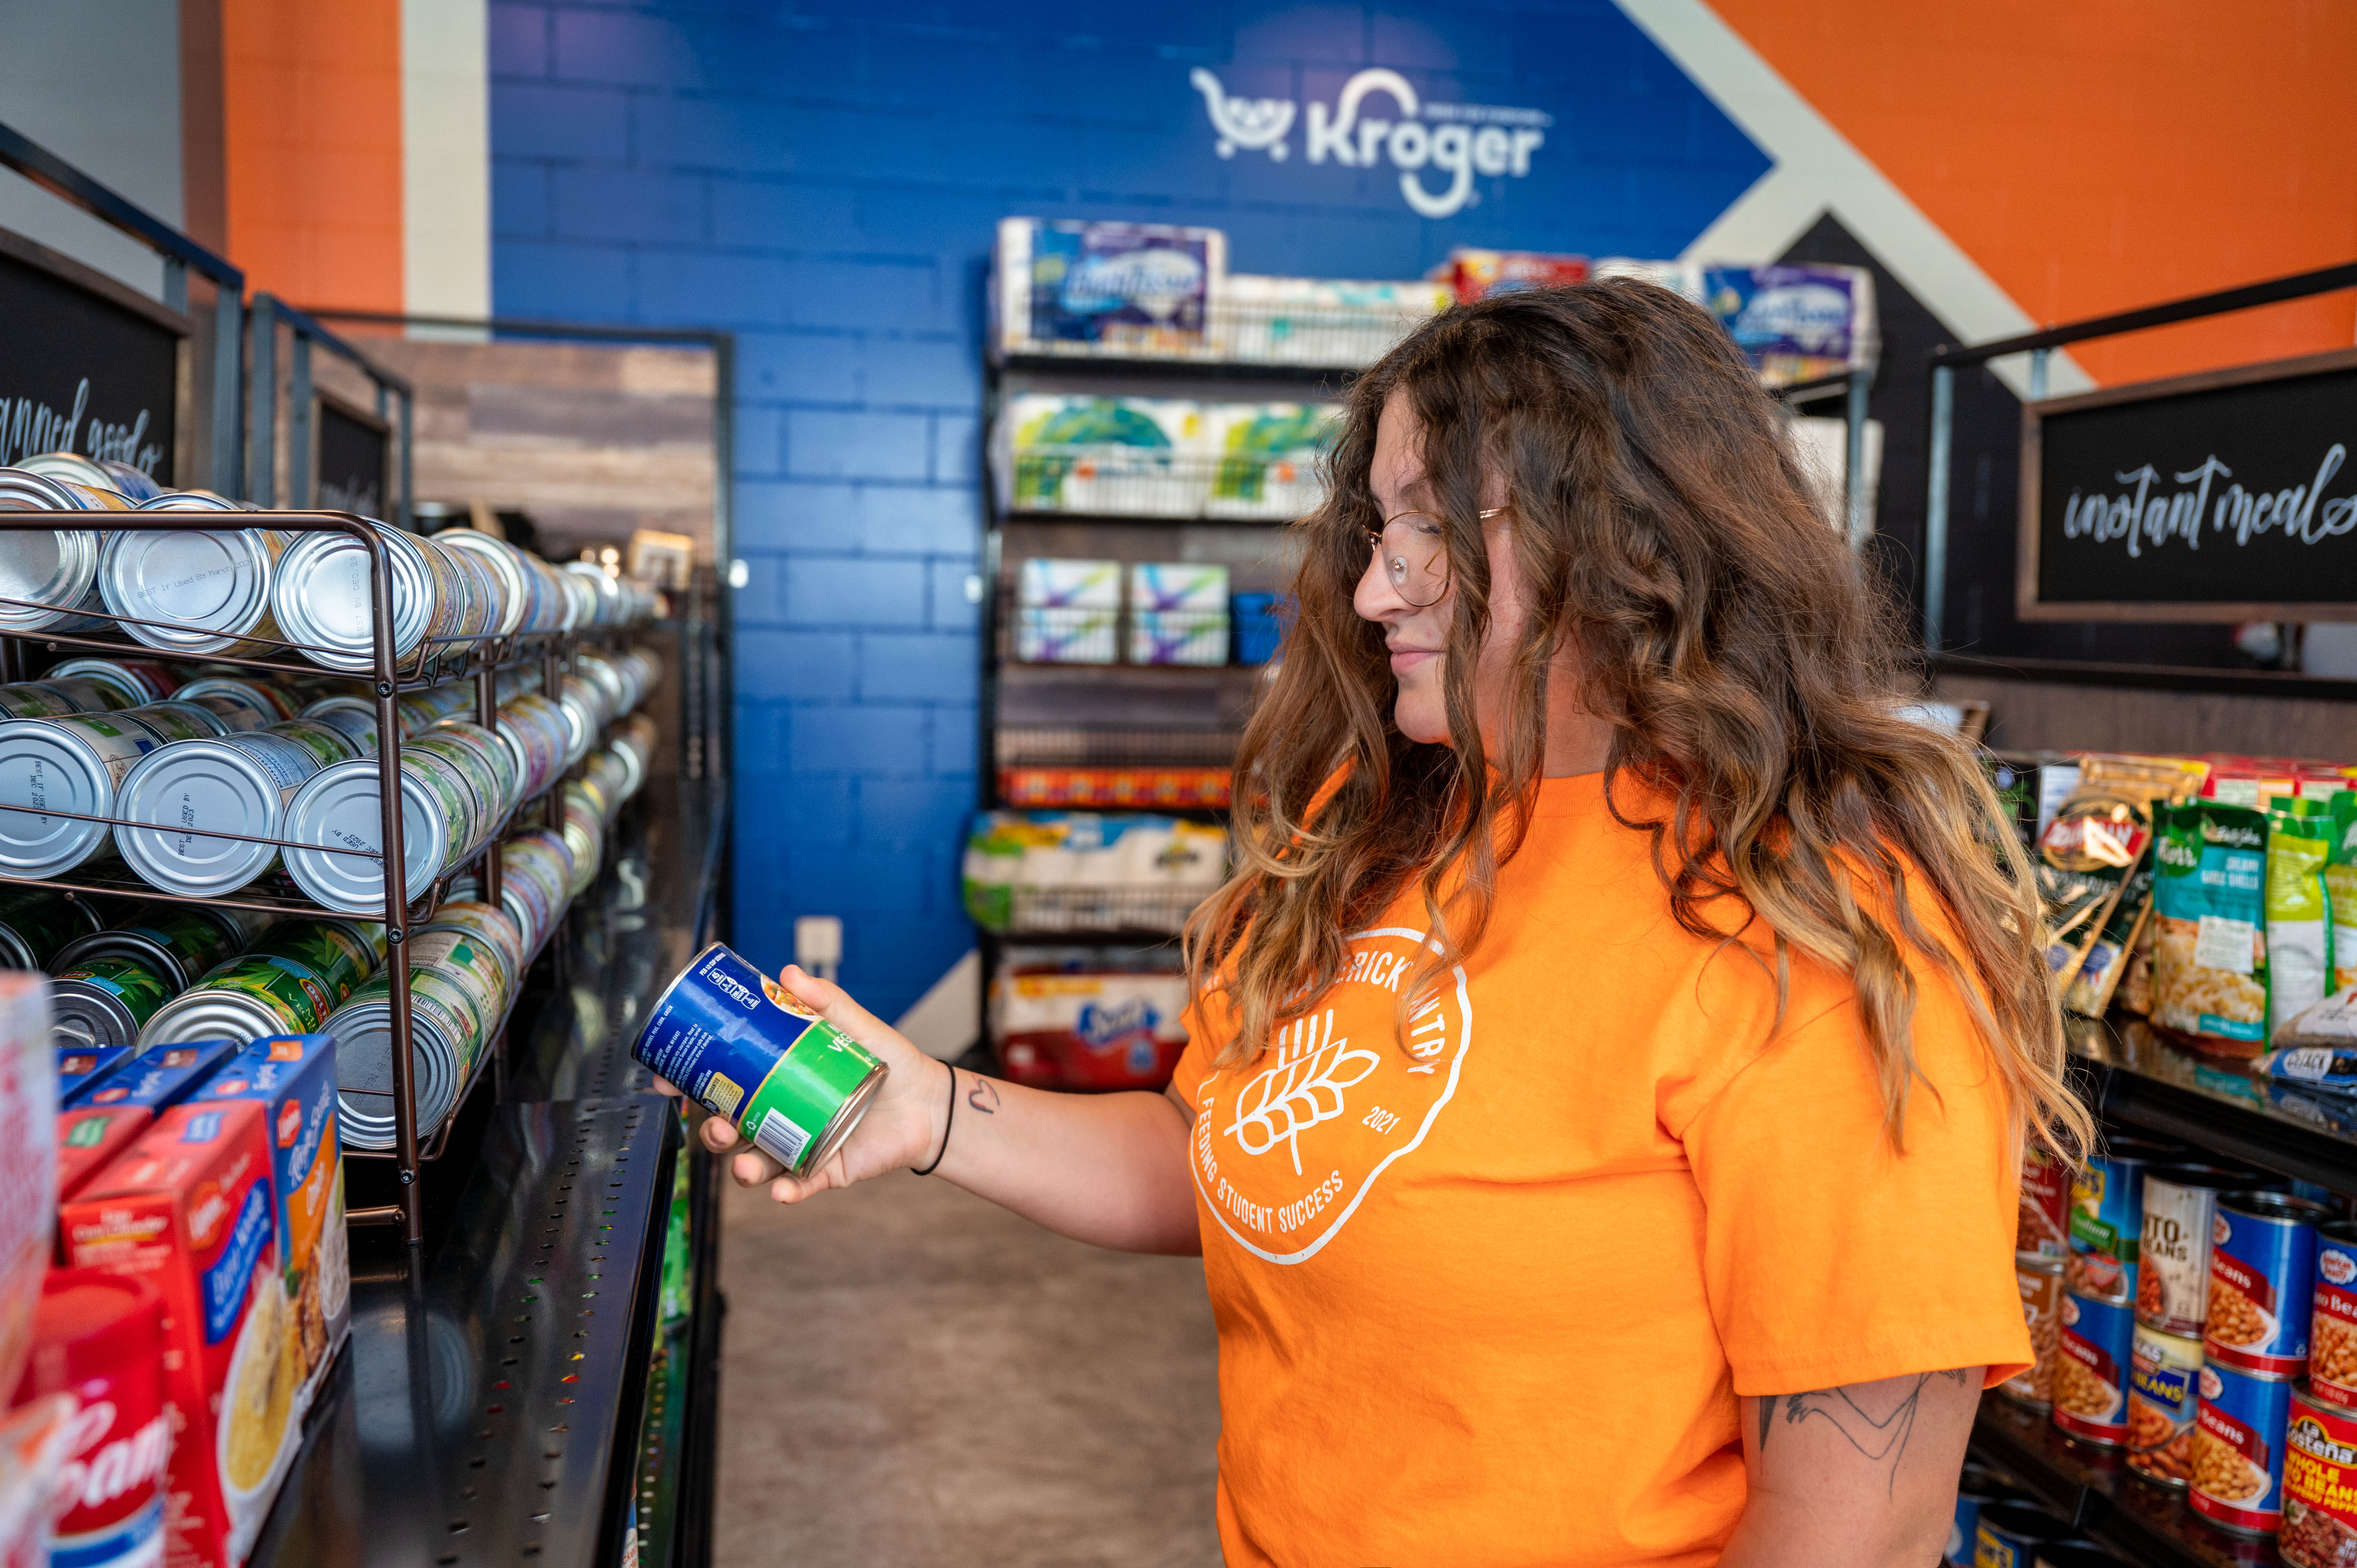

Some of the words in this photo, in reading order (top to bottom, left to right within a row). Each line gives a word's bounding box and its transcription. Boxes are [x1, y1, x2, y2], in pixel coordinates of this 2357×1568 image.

[1307, 67, 1545, 218] Kroger
[2064, 454, 2233, 558] instant
[137, 587, 157, 599] BEST
[174, 576, 194, 587] Used
[195, 572, 207, 581] By
[208, 565, 231, 577] March
[37, 782, 43, 791] IF
[41, 816, 48, 826] BY
[183, 793, 190, 802] BY
[181, 805, 189, 823] USED
[187, 809, 195, 827] 2023
[331, 827, 342, 837] BY
[343, 835, 359, 849] USED
[349, 832, 366, 847] 2023
[177, 839, 186, 856] BEST
[699, 967, 708, 976] PER
[709, 958, 717, 967] CUP
[710, 970, 720, 980] 45
[644, 1033, 655, 1048] POTATOES,
[651, 1025, 660, 1035] PEAS,
[656, 1015, 666, 1026] CORN,
[663, 1005, 673, 1017] GREEN
[672, 1030, 681, 1041] 03431
[677, 1035, 690, 1051] saucepan.
[687, 1026, 695, 1036] Heat
[679, 1047, 689, 1058] Season
[687, 1035, 696, 1045] taste;
[694, 1026, 703, 1037] serve.
[686, 1038, 703, 1061] microwave-safe
[700, 1030, 709, 1040] dish.
[694, 1047, 704, 1058] drain,
[701, 1033, 713, 1048] desired.
[706, 1077, 720, 1098] GUARANTEE
[1362, 1105, 1401, 1135] 2021
[1198, 1097, 1217, 1183] FEEDING
[1217, 1178, 1273, 1234] STUDENT
[1278, 1169, 1344, 1234] SUCCESS
[2303, 1420, 2319, 1439] La
